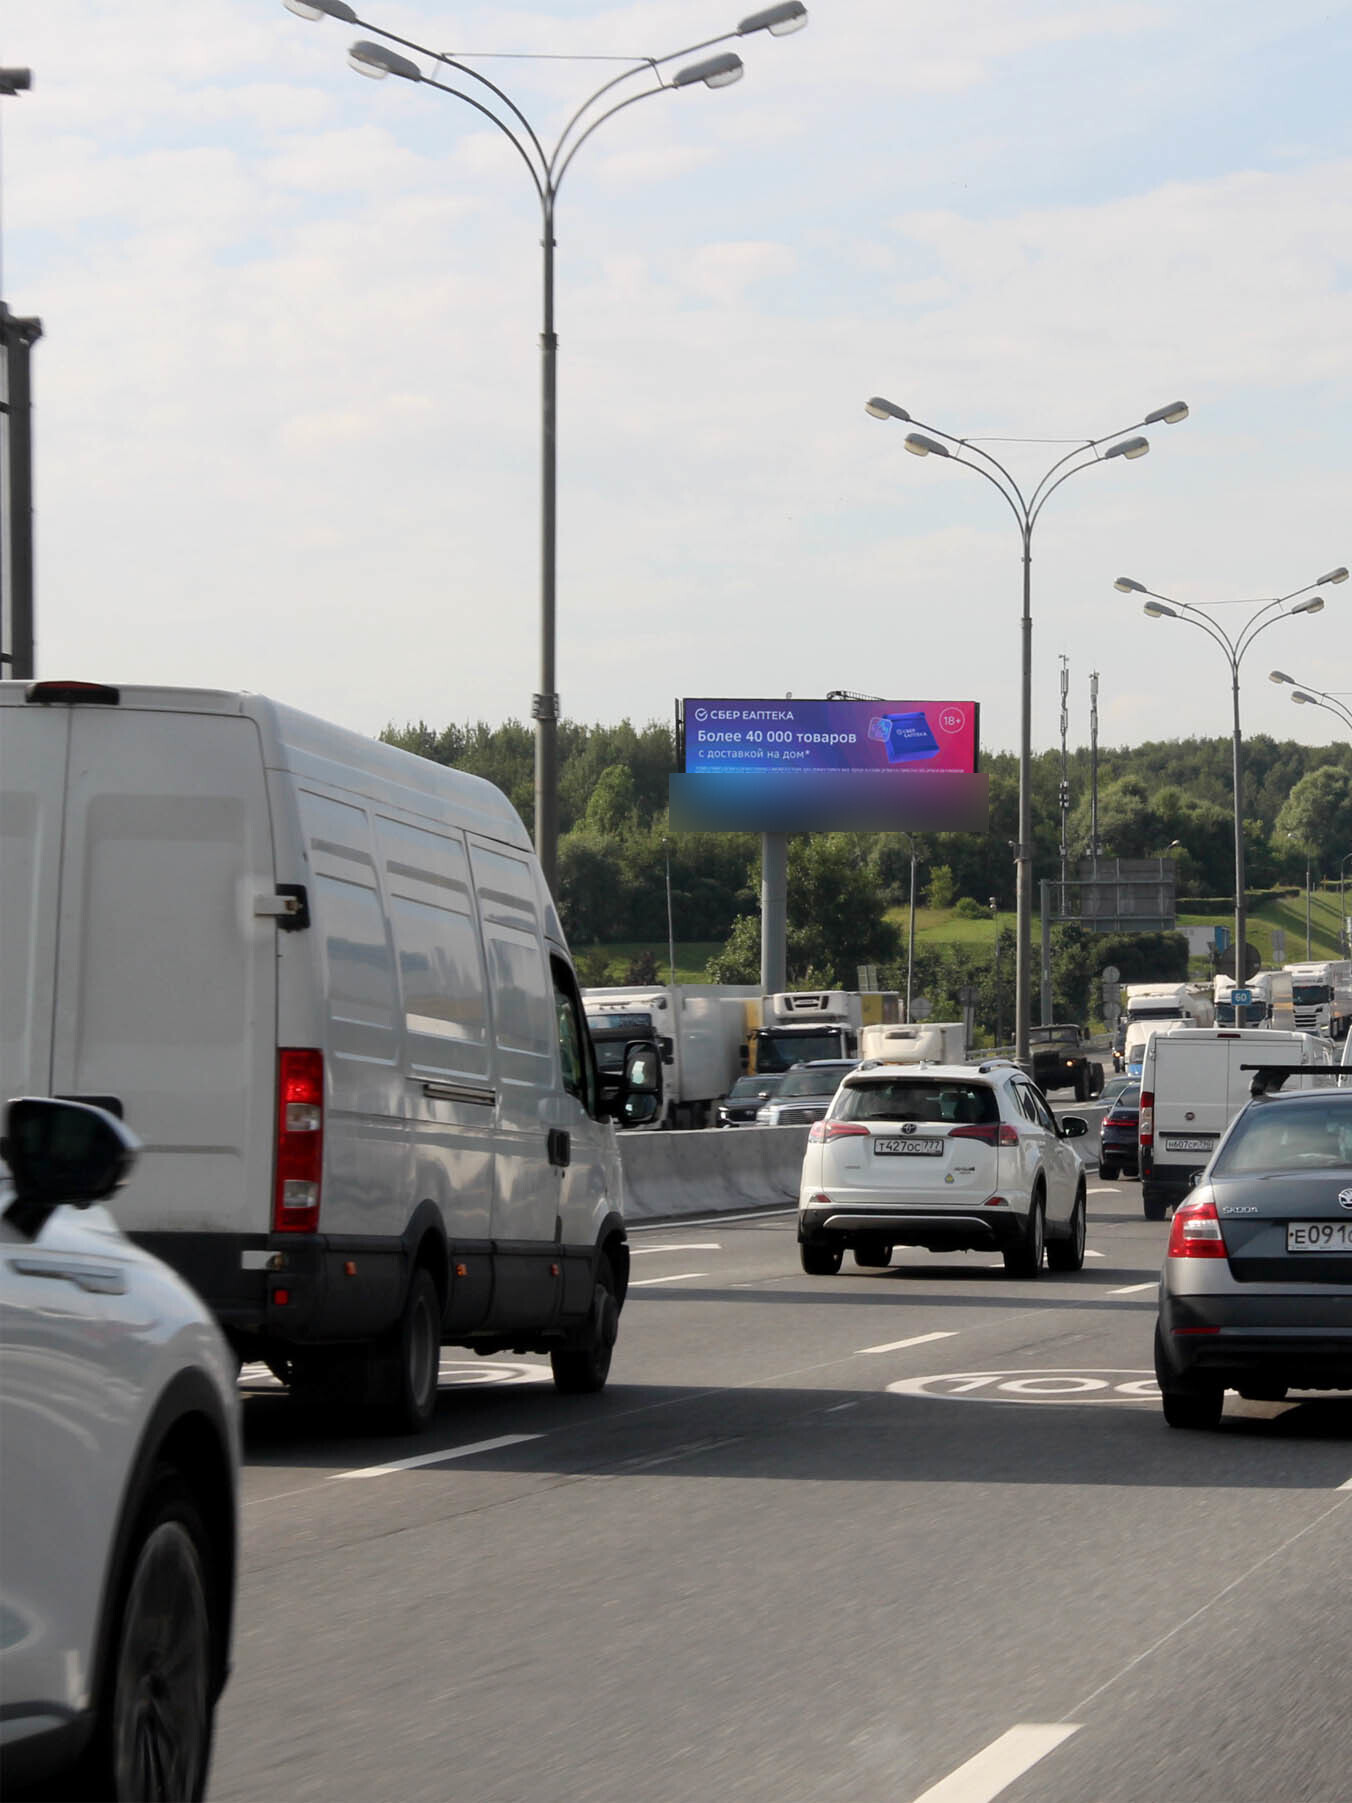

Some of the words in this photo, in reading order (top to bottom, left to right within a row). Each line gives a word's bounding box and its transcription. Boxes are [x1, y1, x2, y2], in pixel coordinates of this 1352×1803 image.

[710, 710, 741, 720] СБЕР
[742, 710, 794, 721] ЕАПТЕКА
[943, 716, 962, 726] 18+
[697, 730, 742, 743] Более
[745, 730, 763, 743] 40
[766, 730, 793, 743] 000
[796, 733, 857, 745] товаров
[698, 751, 705, 759] с
[706, 748, 764, 760] доставкой
[767, 751, 780, 759] на
